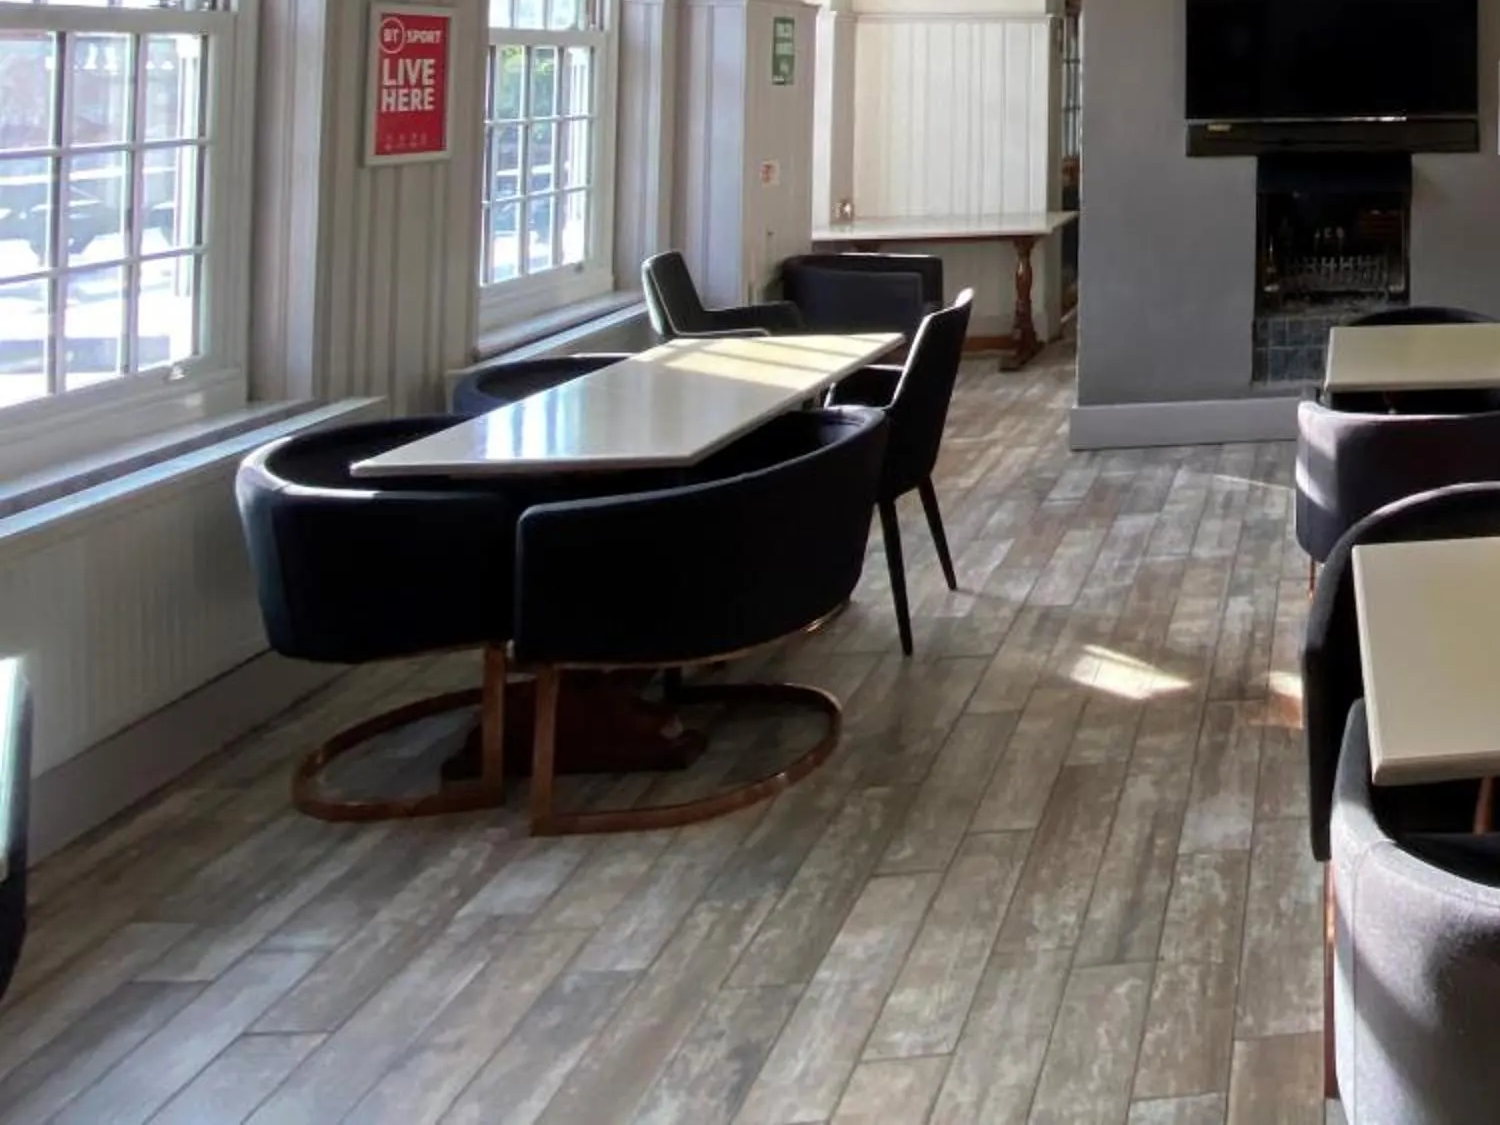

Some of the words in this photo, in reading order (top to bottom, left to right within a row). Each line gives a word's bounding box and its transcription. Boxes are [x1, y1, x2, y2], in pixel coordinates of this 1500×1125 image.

[405, 30, 442, 44] SPORT
[382, 58, 436, 86] LIVE
[381, 88, 436, 113] HERE
